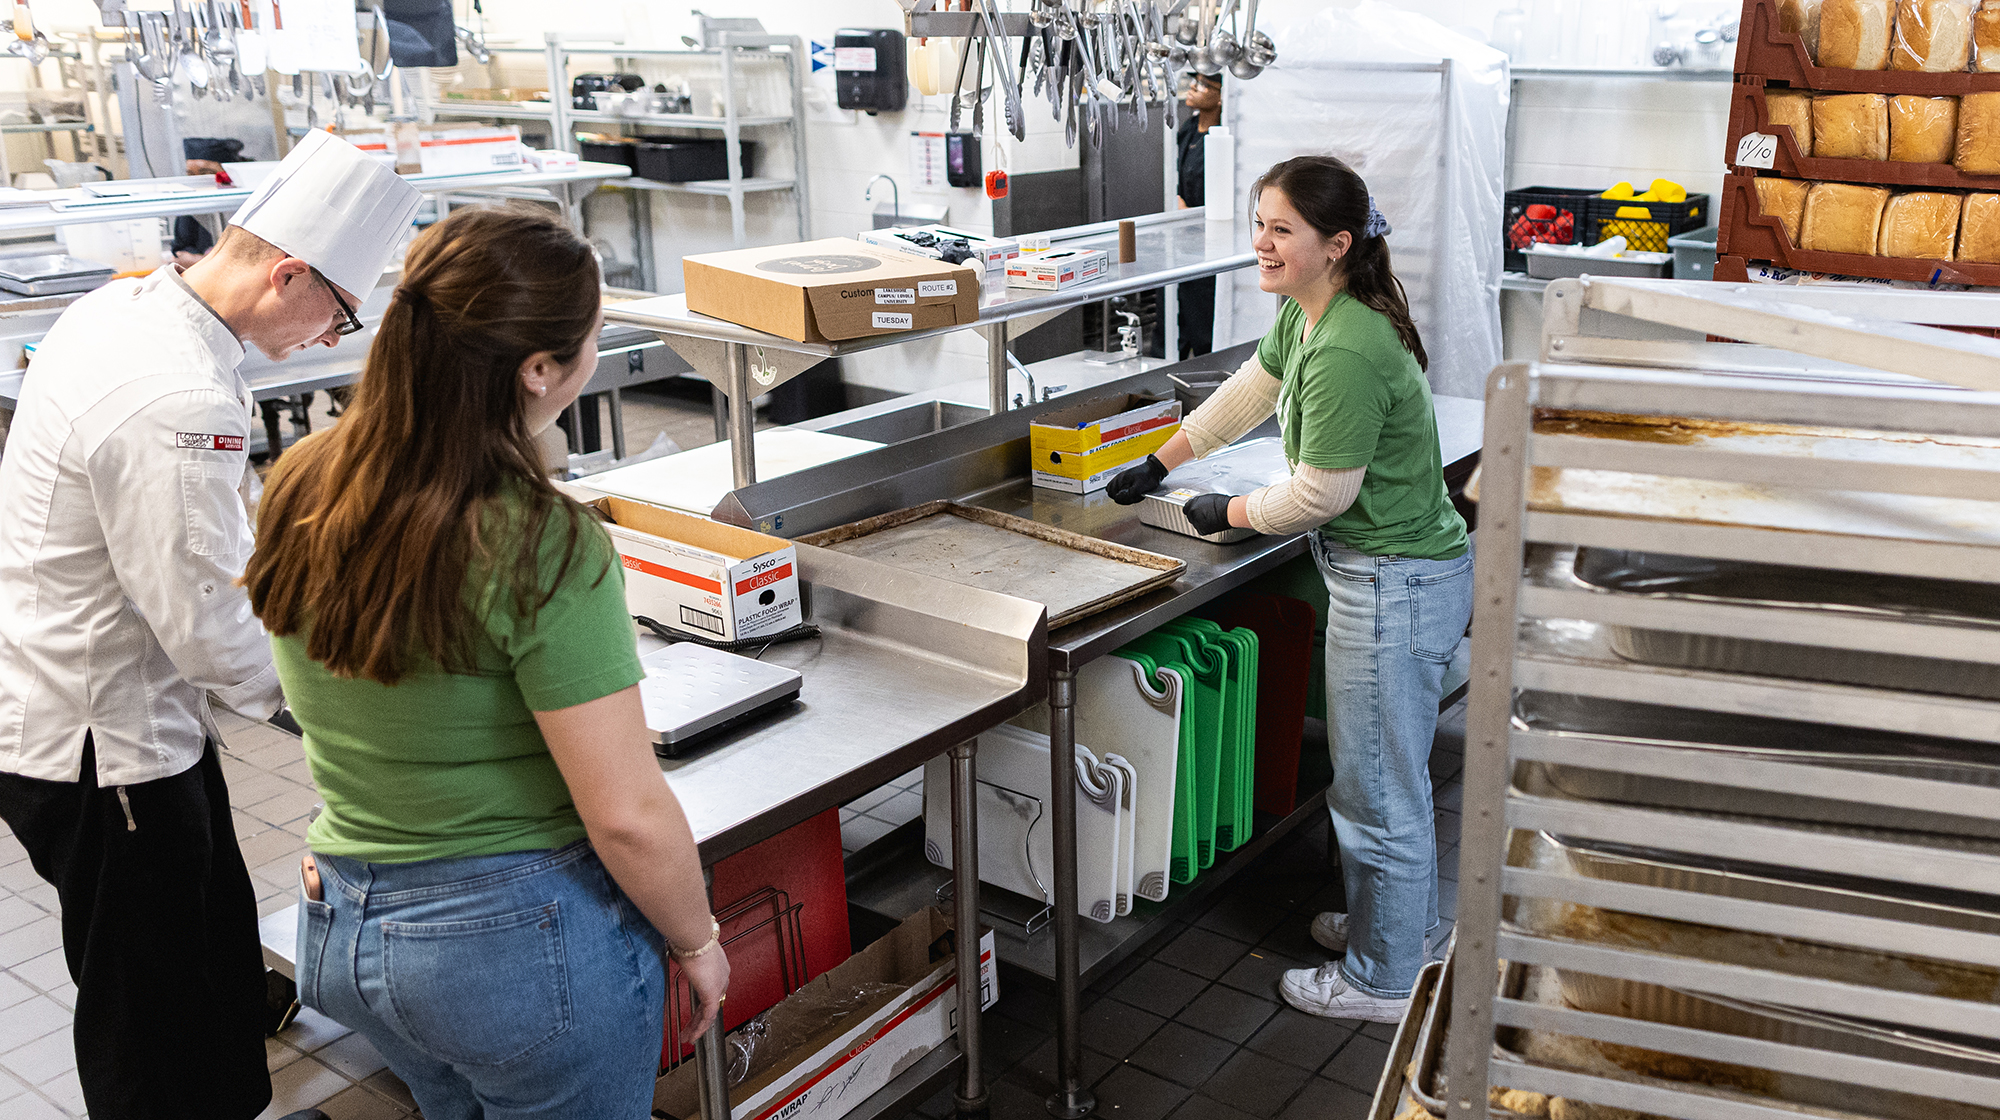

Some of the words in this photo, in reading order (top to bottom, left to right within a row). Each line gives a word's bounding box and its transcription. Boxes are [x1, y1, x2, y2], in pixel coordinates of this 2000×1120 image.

[1740, 136, 1772, 162] 11/10
[840, 288, 875, 299] Custom
[922, 284, 945, 292] ROUTE
[877, 316, 909, 325] TUESDAY
[1123, 423, 1143, 436] Classic
[752, 558, 776, 574] Sysco
[749, 570, 780, 590] Classic
[738, 610, 762, 626] PLASTIC
[761, 605, 778, 617] FOOD
[778, 598, 795, 611] WRAP
[780, 1093, 808, 1119] WRAP
